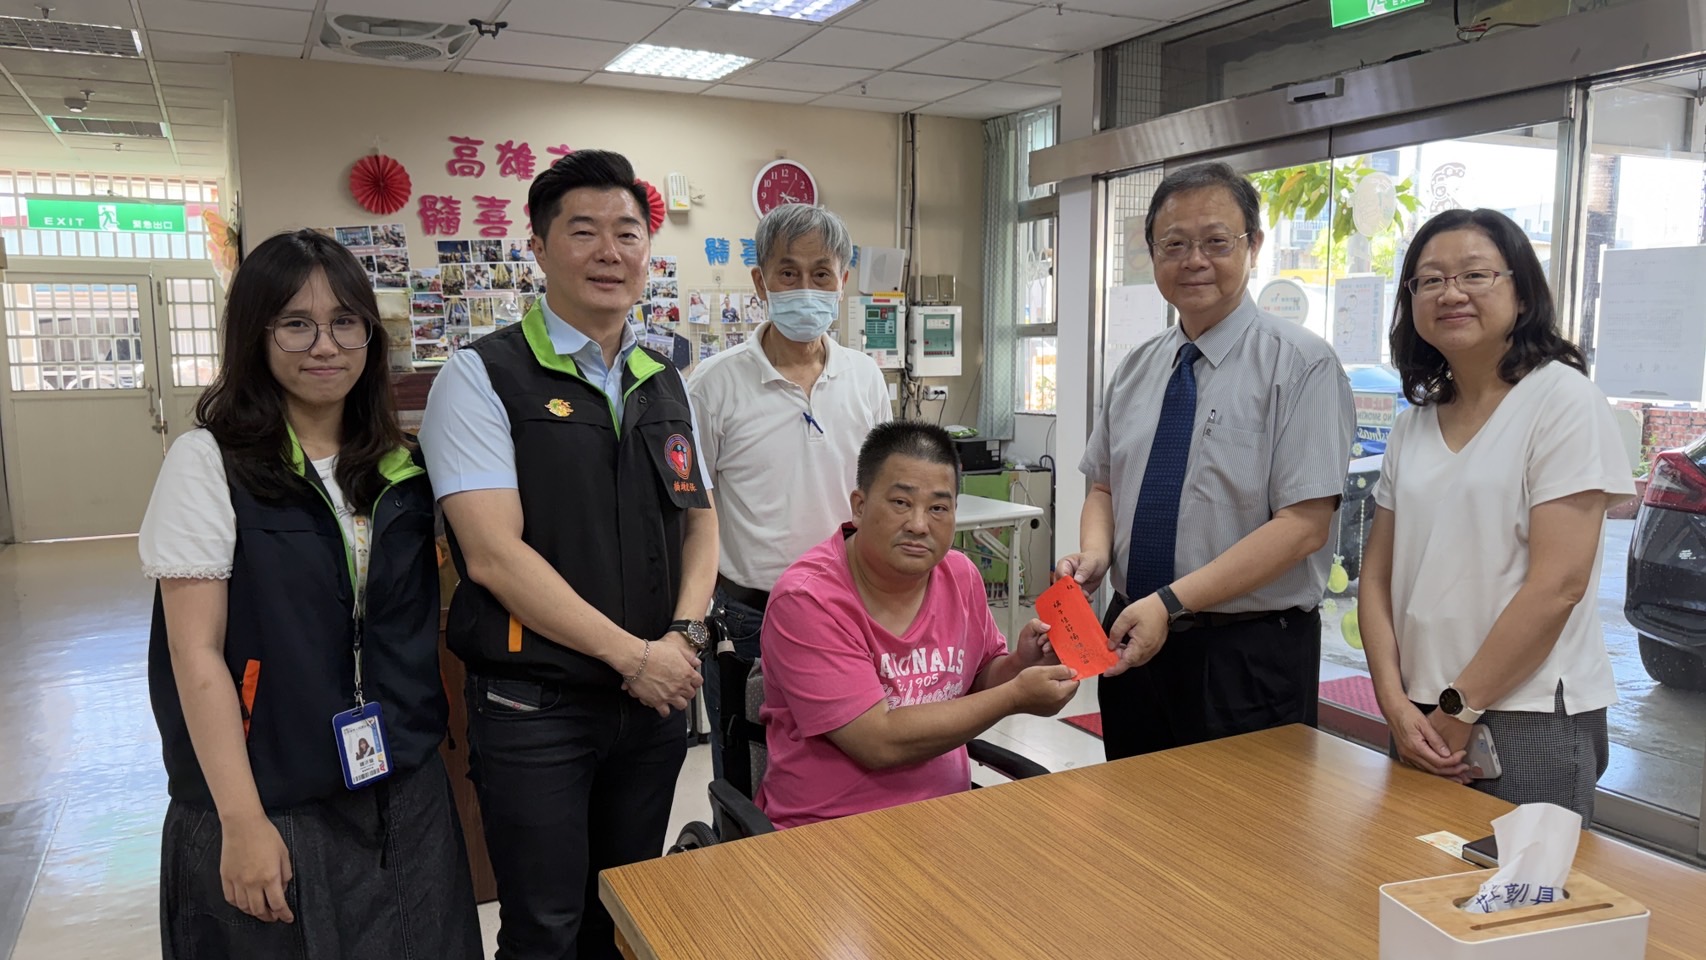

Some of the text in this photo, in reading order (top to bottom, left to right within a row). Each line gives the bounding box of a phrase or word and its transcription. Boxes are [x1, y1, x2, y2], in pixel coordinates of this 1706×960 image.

[771, 171, 778, 180] 11
[781, 169, 789, 177] 12
[794, 172, 798, 181] 1
[764, 179, 771, 188] 10
[800, 180, 806, 189] 2
[761, 191, 767, 200] 9
[803, 192, 808, 201] 3
[417, 194, 531, 238] 髓喜
[44, 217, 85, 226] EXIT
[132, 219, 173, 230] 緊急出口
[908, 673, 939, 690] 1905
